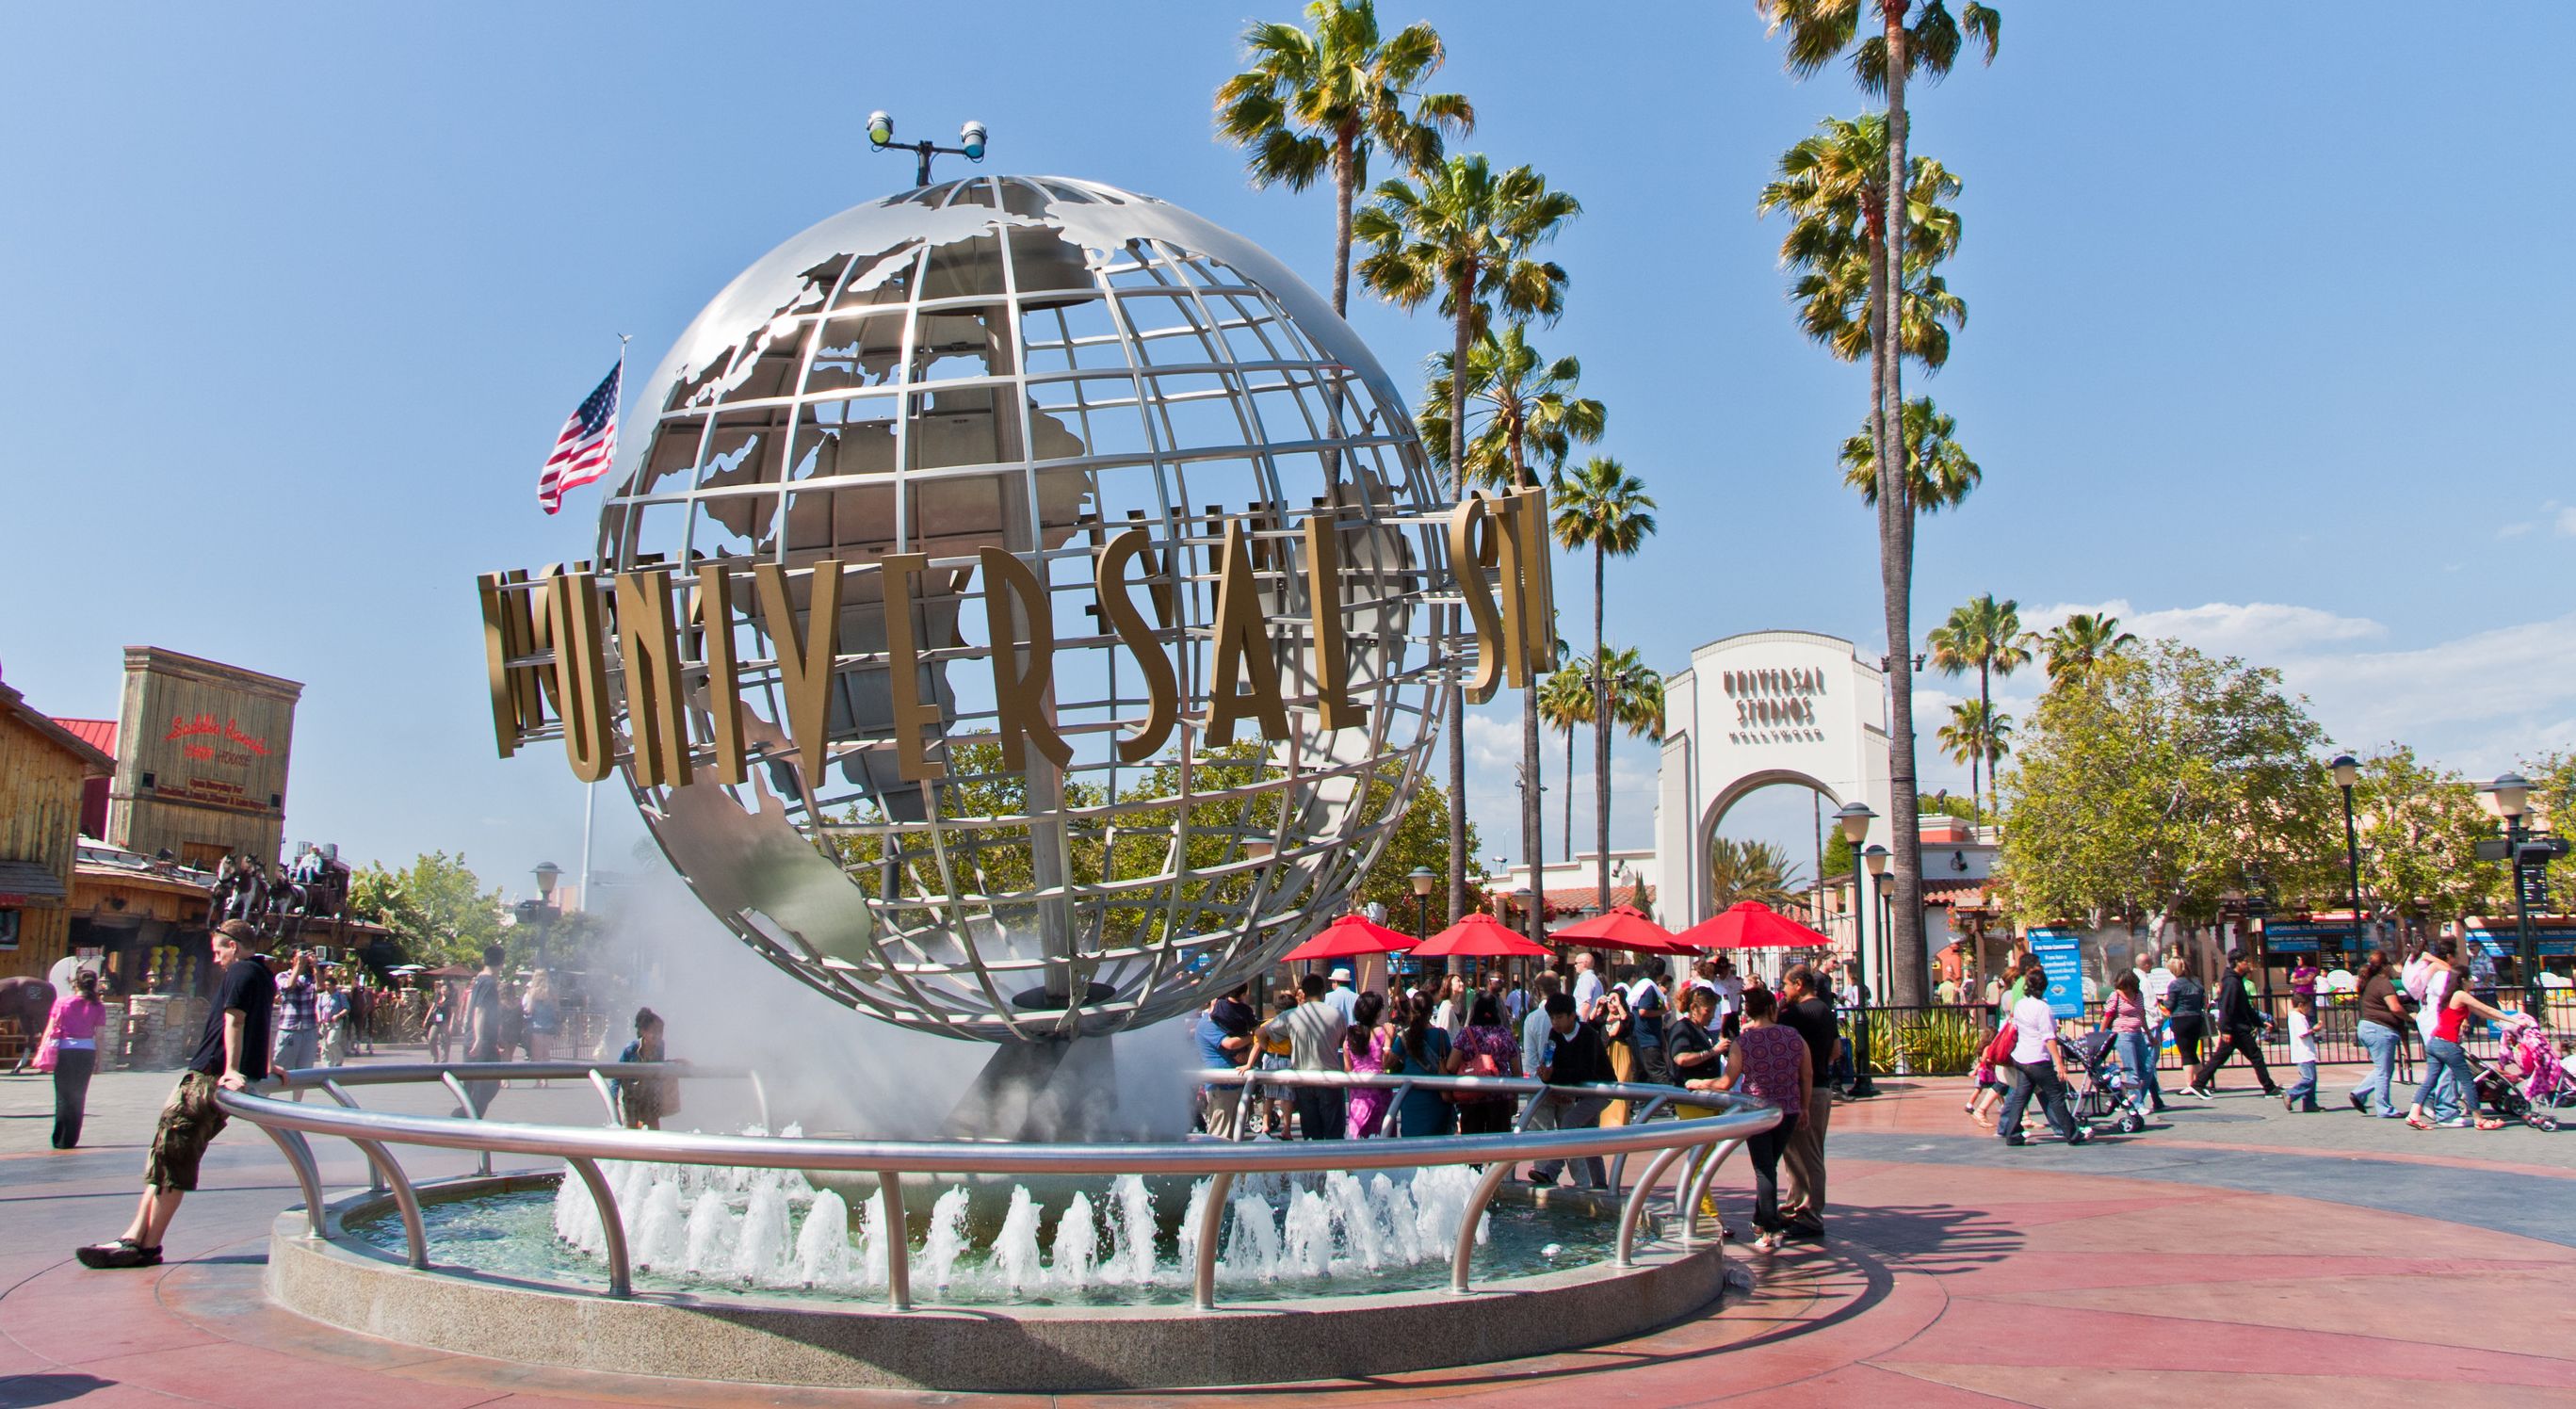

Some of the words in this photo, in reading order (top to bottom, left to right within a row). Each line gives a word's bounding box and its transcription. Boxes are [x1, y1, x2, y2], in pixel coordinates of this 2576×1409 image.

[547, 516, 1367, 787] UNIVERSAL
[1724, 666, 1824, 696] UNIVERSAL
[1736, 697, 1814, 725] STUDIOS
[166, 712, 220, 741] Saddle
[1729, 729, 1823, 743] HOLLYWOOD
[218, 749, 251, 767] HOUSE
